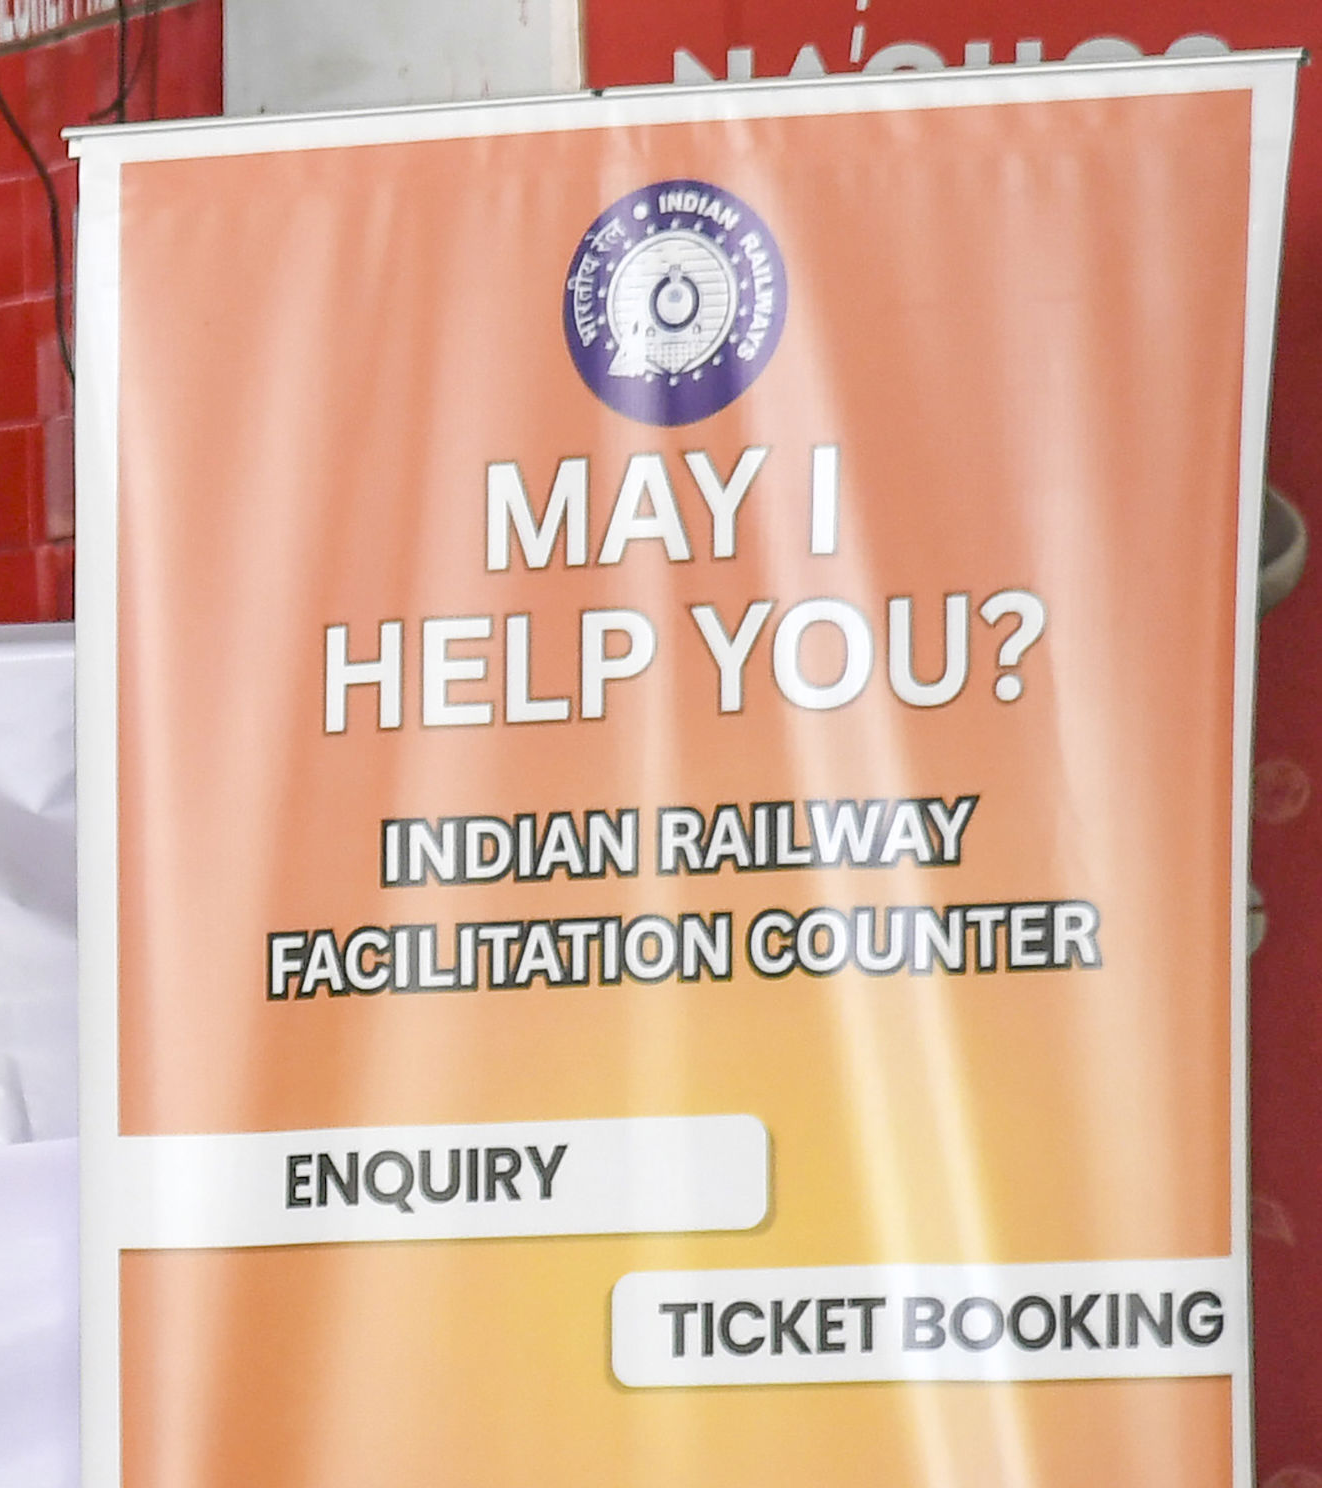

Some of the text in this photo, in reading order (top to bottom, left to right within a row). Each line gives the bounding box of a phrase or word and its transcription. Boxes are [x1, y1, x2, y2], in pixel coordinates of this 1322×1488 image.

[658, 191, 773, 361] INDIAN RAILWAYS
[485, 442, 842, 572] MAY I
[322, 587, 1047, 735] HELP YOU?
[381, 795, 979, 888] INDIAN RAILWAY
[266, 899, 1102, 999] FACILITATION COUNTER
[285, 1143, 568, 1215] ENQUIRY
[658, 1290, 1226, 1360] TICKET BOOKING
